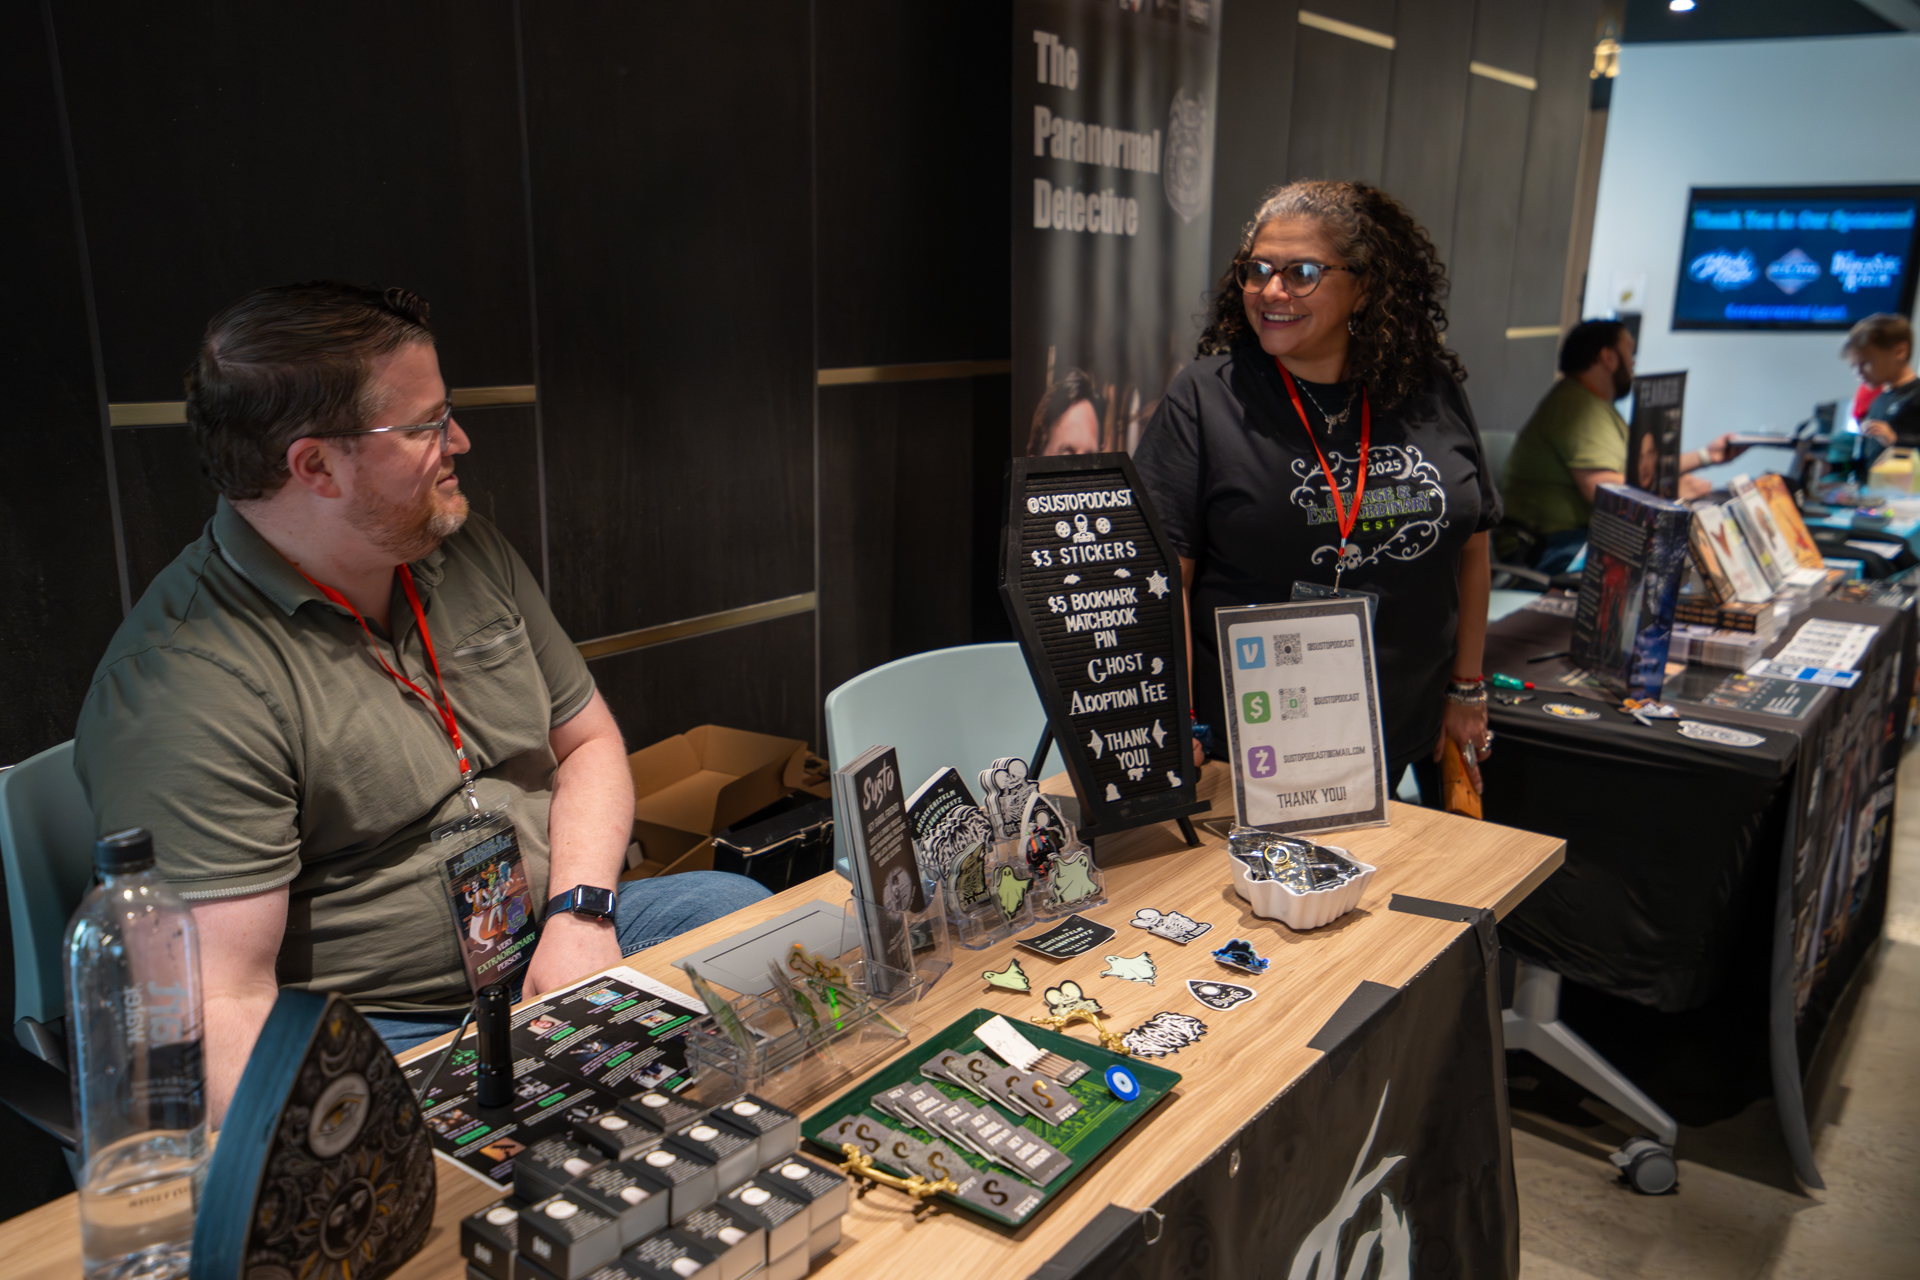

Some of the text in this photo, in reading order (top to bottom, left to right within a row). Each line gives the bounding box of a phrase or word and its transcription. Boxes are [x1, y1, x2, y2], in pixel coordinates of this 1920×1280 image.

[1033, 30, 1079, 91] The
[1034, 105, 1161, 174] Paranormal
[1033, 178, 1138, 236] Detective
[1367, 459, 1401, 477] 2025
[1027, 489, 1133, 514] @SUSTOPODCAST
[1326, 485, 1411, 508] SRNGE &
[1031, 541, 1137, 567] $3 STICKERS
[1048, 587, 1138, 613] $5 BOOKMARK
[1064, 607, 1138, 633] MATCHBOOK
[1094, 629, 1118, 649] PIN
[1307, 639, 1355, 651] @SUSTOPODCAST
[1087, 653, 1143, 683] GHOST
[1069, 680, 1168, 715] ADOPTION FEE
[1104, 727, 1151, 751] THANK
[1115, 748, 1151, 772] YOU!
[863, 759, 895, 811] Susto
[1277, 786, 1347, 809] THANK YOU!
[477, 931, 536, 975] EXTRAORDINARY
[497, 937, 513, 951] VERY
[497, 952, 522, 972] PERSON
